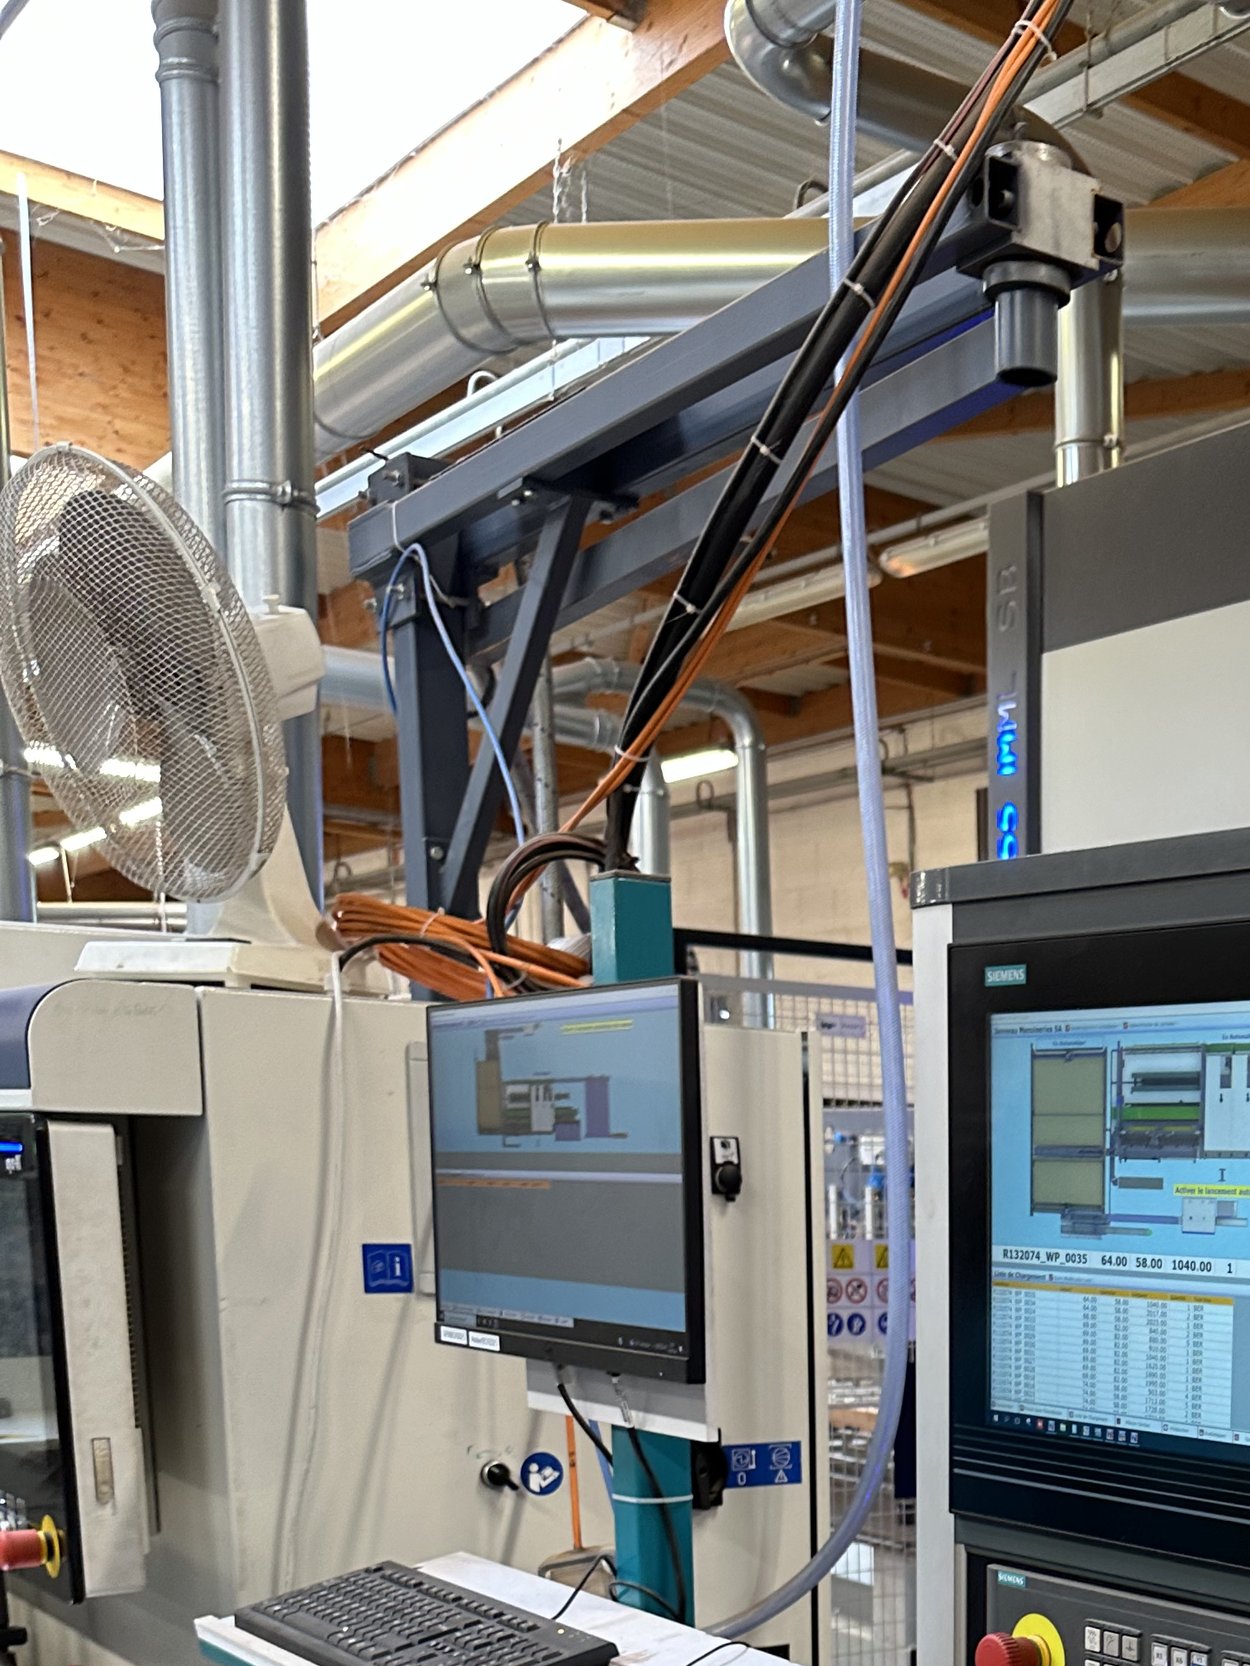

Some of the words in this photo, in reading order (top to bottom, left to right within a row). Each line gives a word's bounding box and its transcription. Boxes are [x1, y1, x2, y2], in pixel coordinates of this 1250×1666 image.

[987, 970, 1025, 982] SIEMENS
[1205, 1187, 1237, 1195] lancement
[1002, 1249, 1088, 1265] R132074_WP_0035
[1101, 1255, 1128, 1268] 64.00
[1135, 1257, 1163, 1270] 58.00
[1171, 1259, 1213, 1273] 1040.00
[1226, 1262, 1233, 1274] 1
[998, 1572, 1025, 1585] SIEMENS
